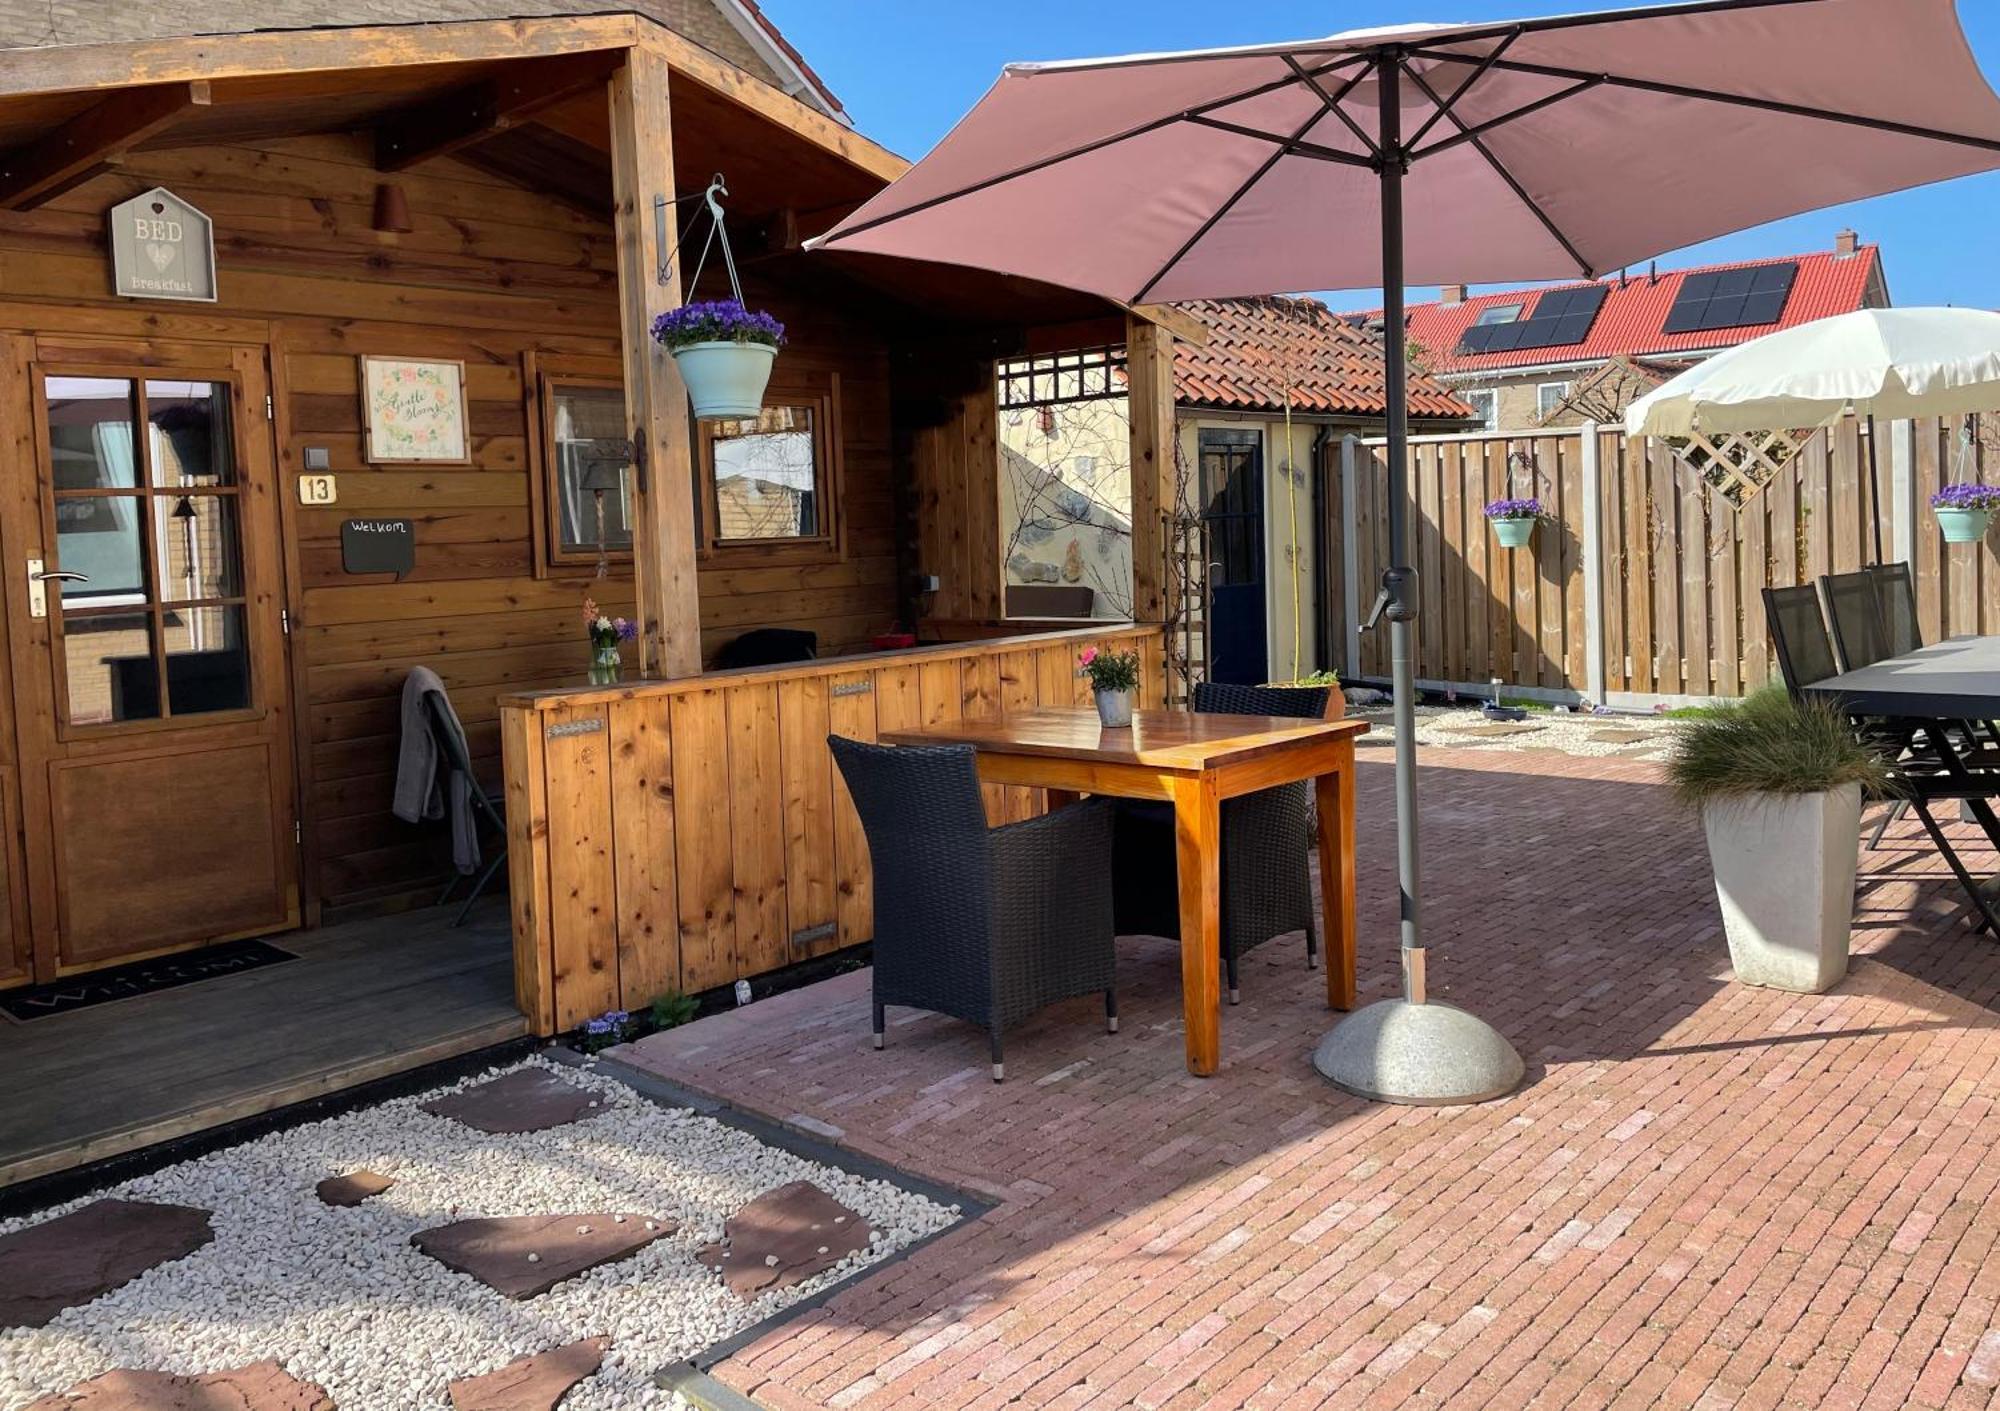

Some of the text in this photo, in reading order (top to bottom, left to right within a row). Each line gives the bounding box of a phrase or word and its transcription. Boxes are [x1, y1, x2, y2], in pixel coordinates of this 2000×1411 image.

[134, 218, 182, 242] BED
[131, 277, 192, 293] Breakfast
[308, 479, 329, 501] 13
